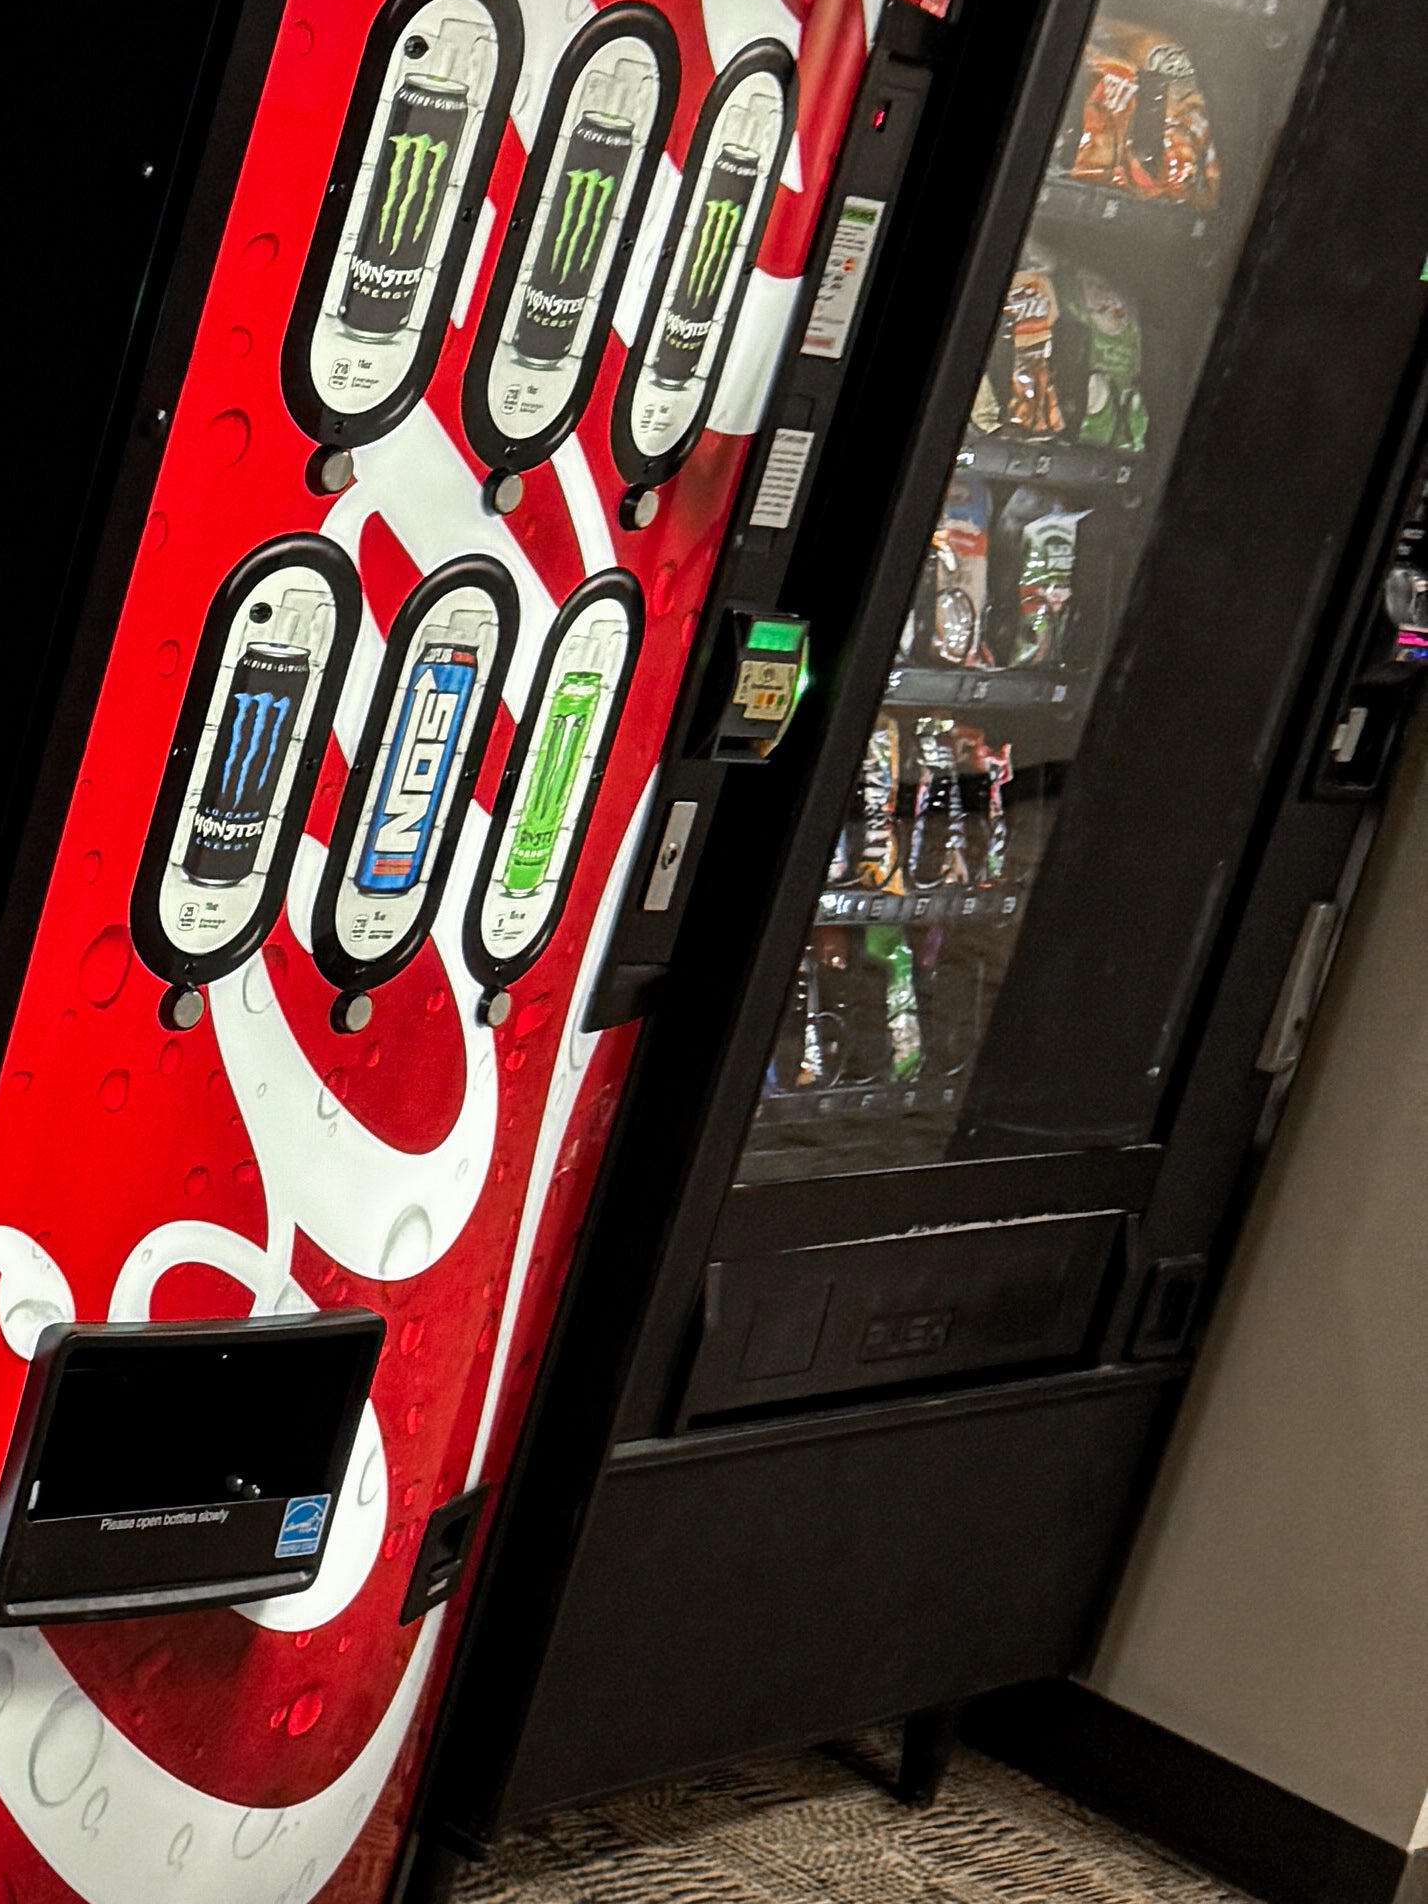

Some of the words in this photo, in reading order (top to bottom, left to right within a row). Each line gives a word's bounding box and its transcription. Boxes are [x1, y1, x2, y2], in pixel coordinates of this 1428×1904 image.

[374, 686, 459, 853] NOS
[100, 1518, 135, 1531] Please
[136, 1514, 163, 1530] open
[163, 1511, 197, 1526] bottles
[197, 1507, 230, 1524] slowly
